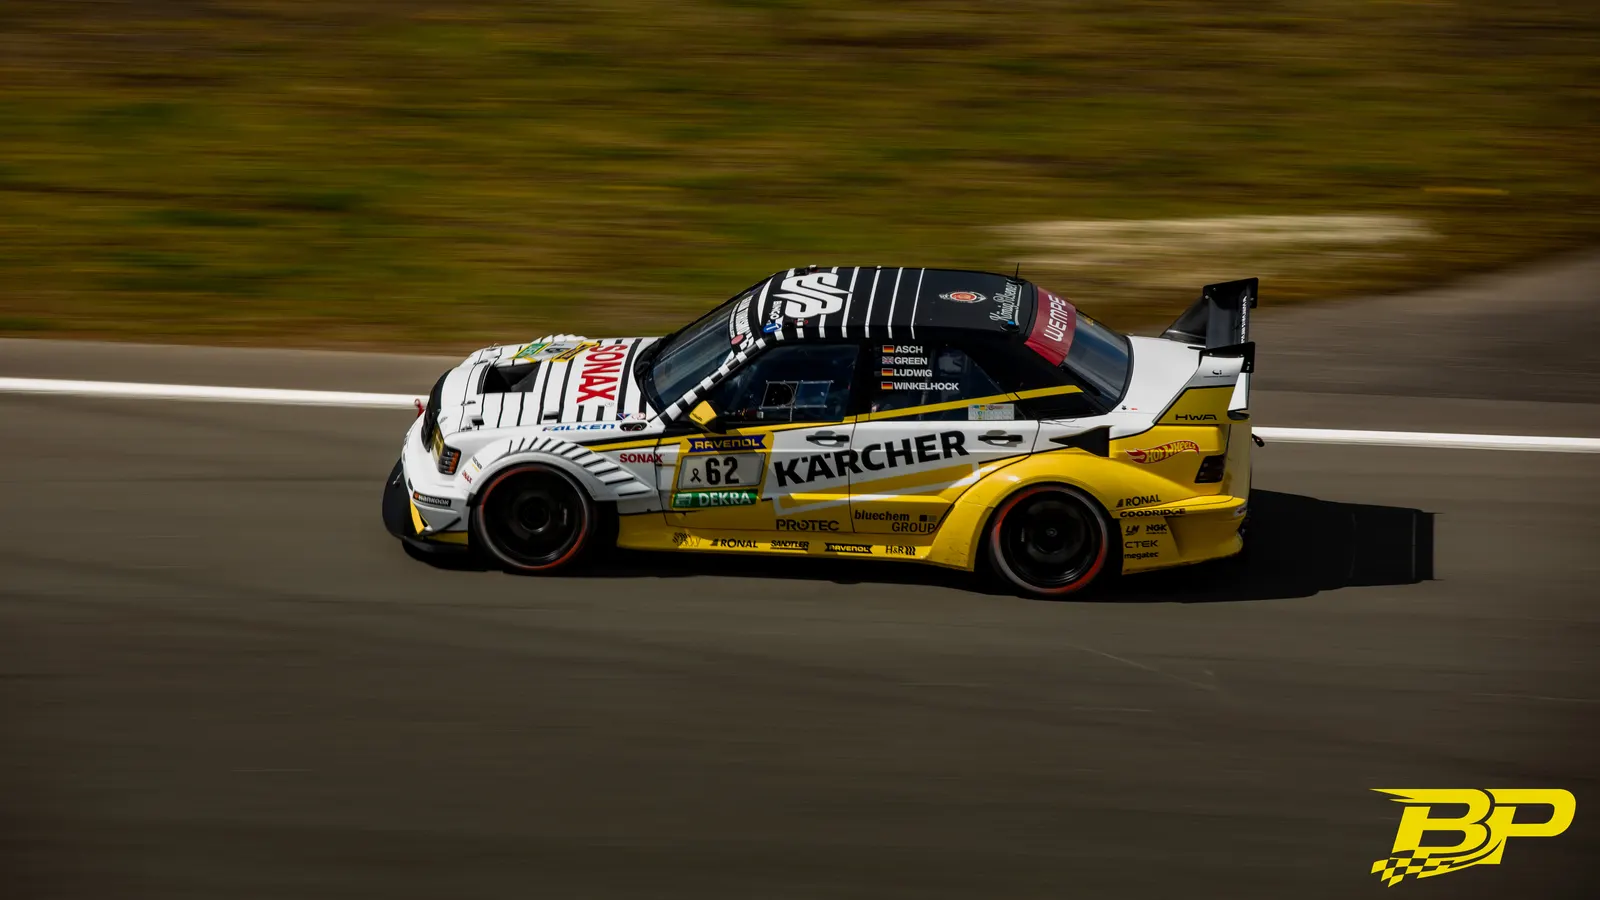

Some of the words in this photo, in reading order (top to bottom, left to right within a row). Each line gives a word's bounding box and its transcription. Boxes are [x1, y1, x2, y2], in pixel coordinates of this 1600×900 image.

[1043, 294, 1067, 342] WEMPE
[895, 345, 923, 354] ASCH
[894, 357, 928, 365] GREEN
[576, 344, 628, 404] SONAX
[894, 368, 933, 377] LUDWIG
[894, 382, 960, 391] WINKELHOCK
[542, 423, 616, 432] FALKEN
[694, 437, 760, 450] RAVENOL
[620, 453, 663, 464] SONAX
[774, 430, 970, 487] KÄRCHER
[1146, 447, 1165, 463] HOT
[705, 456, 740, 485] 62
[699, 491, 752, 507] DEKRA
[1125, 494, 1162, 507] RONAL
[854, 509, 910, 522] bluechem
[1120, 507, 1186, 518] GOODRIDGE
[776, 519, 839, 531] PROTEC
[891, 522, 936, 533] GROUP
[1146, 523, 1167, 532] NGK
[720, 538, 759, 548] RONAL
[770, 540, 810, 549] SANDTLER
[829, 543, 868, 553] RAVENOL
[1125, 538, 1159, 549] CTEK
[885, 546, 904, 554] H&R
[1124, 550, 1159, 561] megatec
